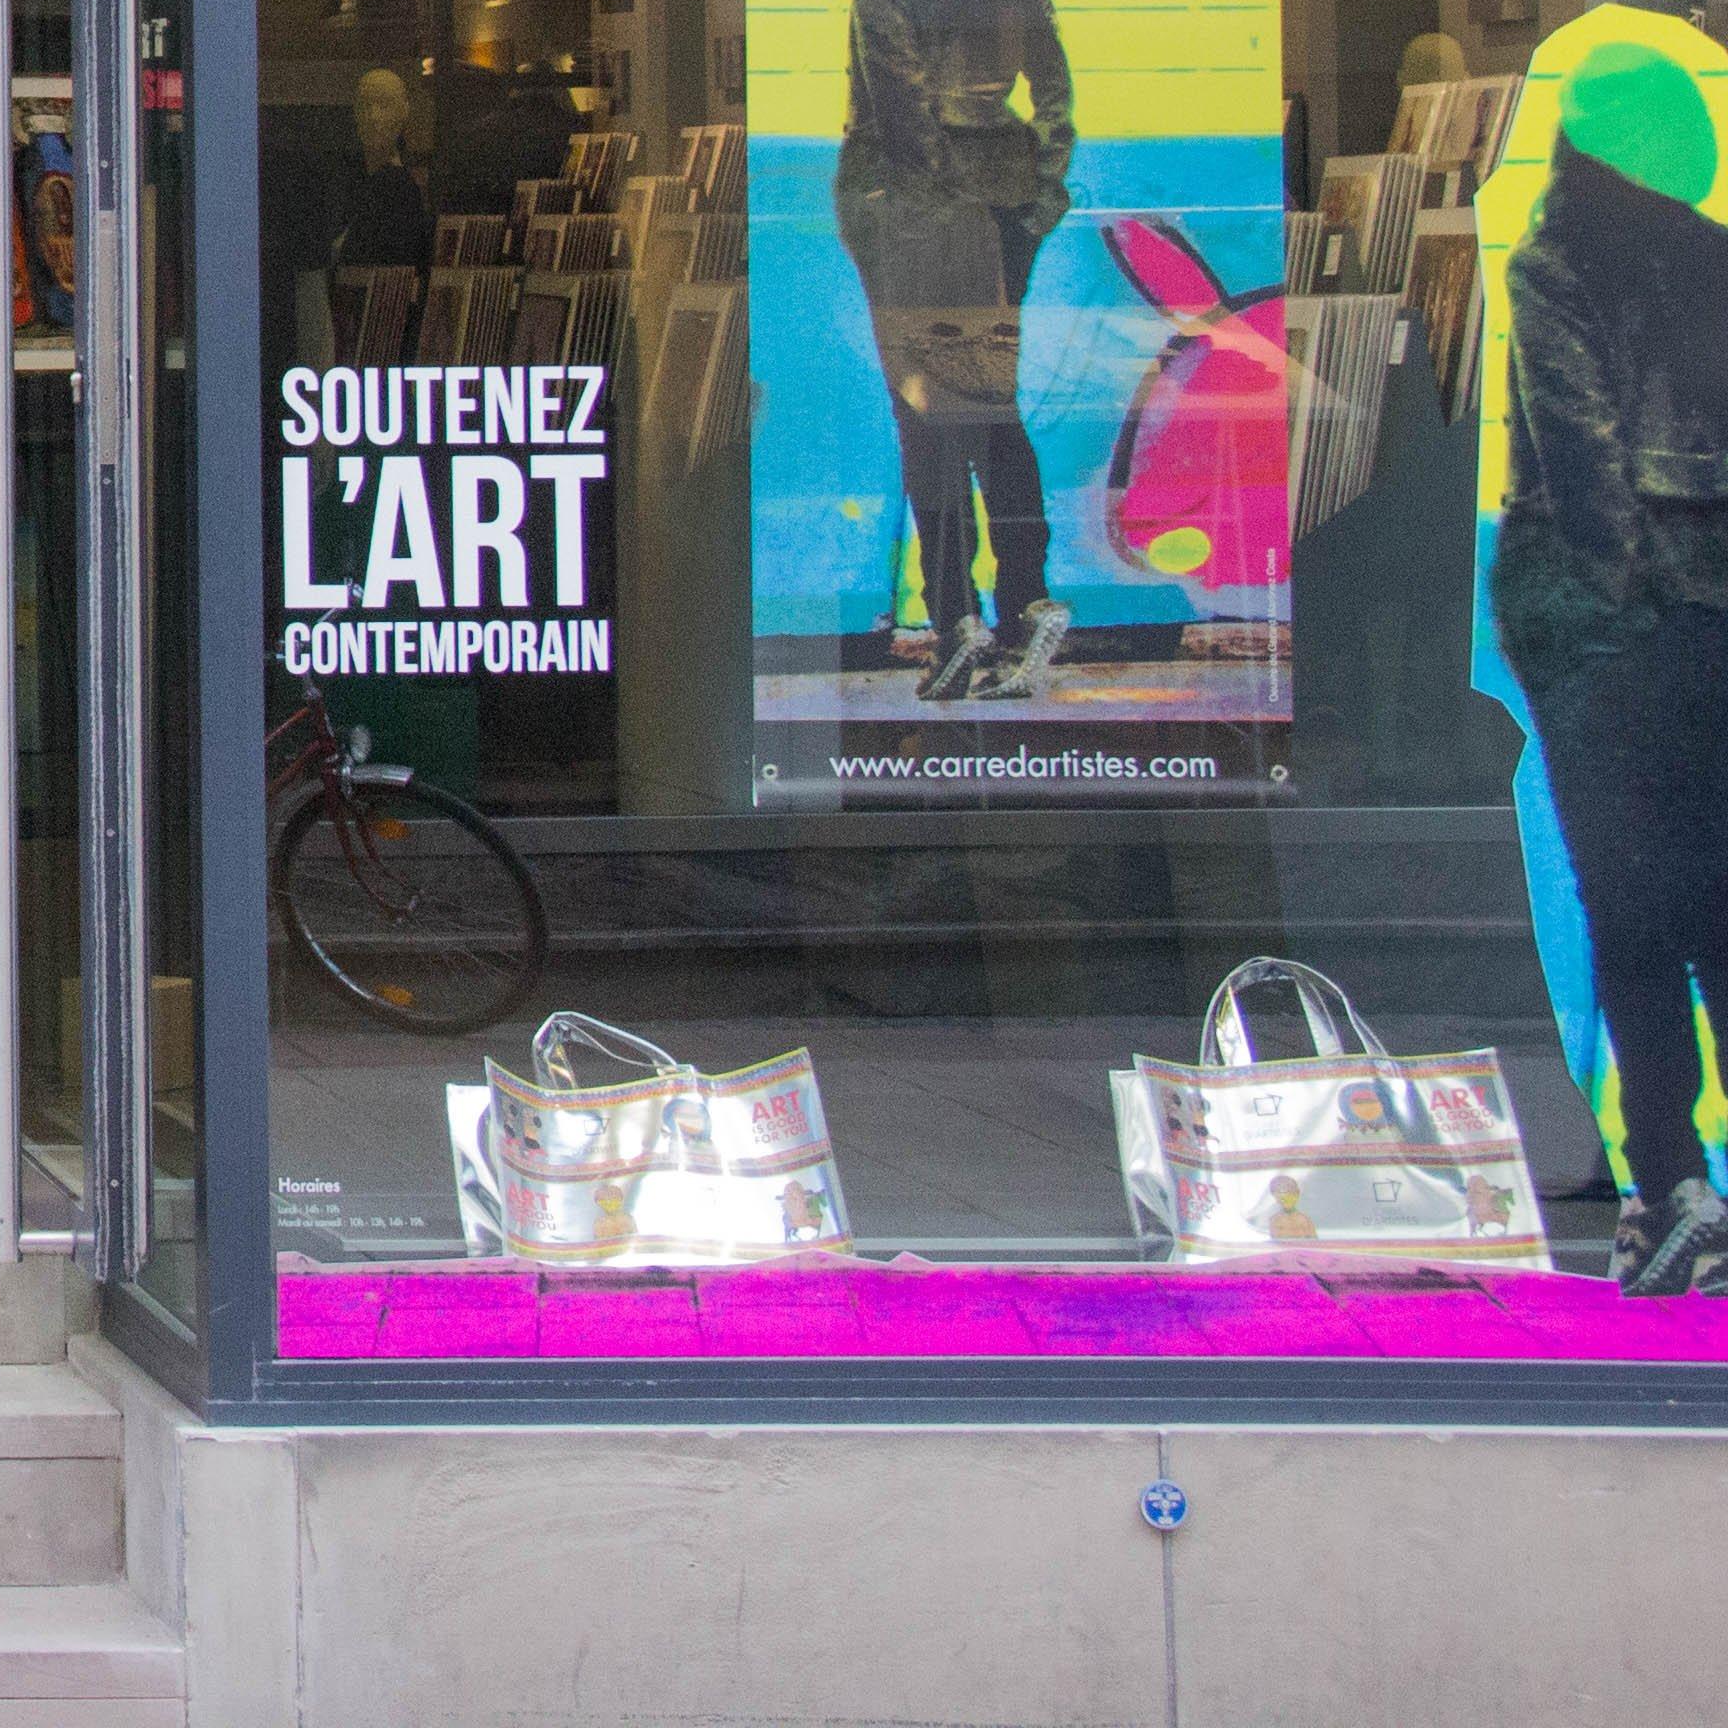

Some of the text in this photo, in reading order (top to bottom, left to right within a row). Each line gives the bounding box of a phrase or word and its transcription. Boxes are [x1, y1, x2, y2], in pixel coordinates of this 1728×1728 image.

[281, 364, 607, 448] SOUTENEZ
[282, 453, 607, 610] L'ART
[283, 617, 610, 675] CONTEMPORAIN
[829, 745, 1216, 780] www.carredartistes.com
[751, 1089, 800, 1123] ART
[277, 1177, 341, 1193] Horaires
